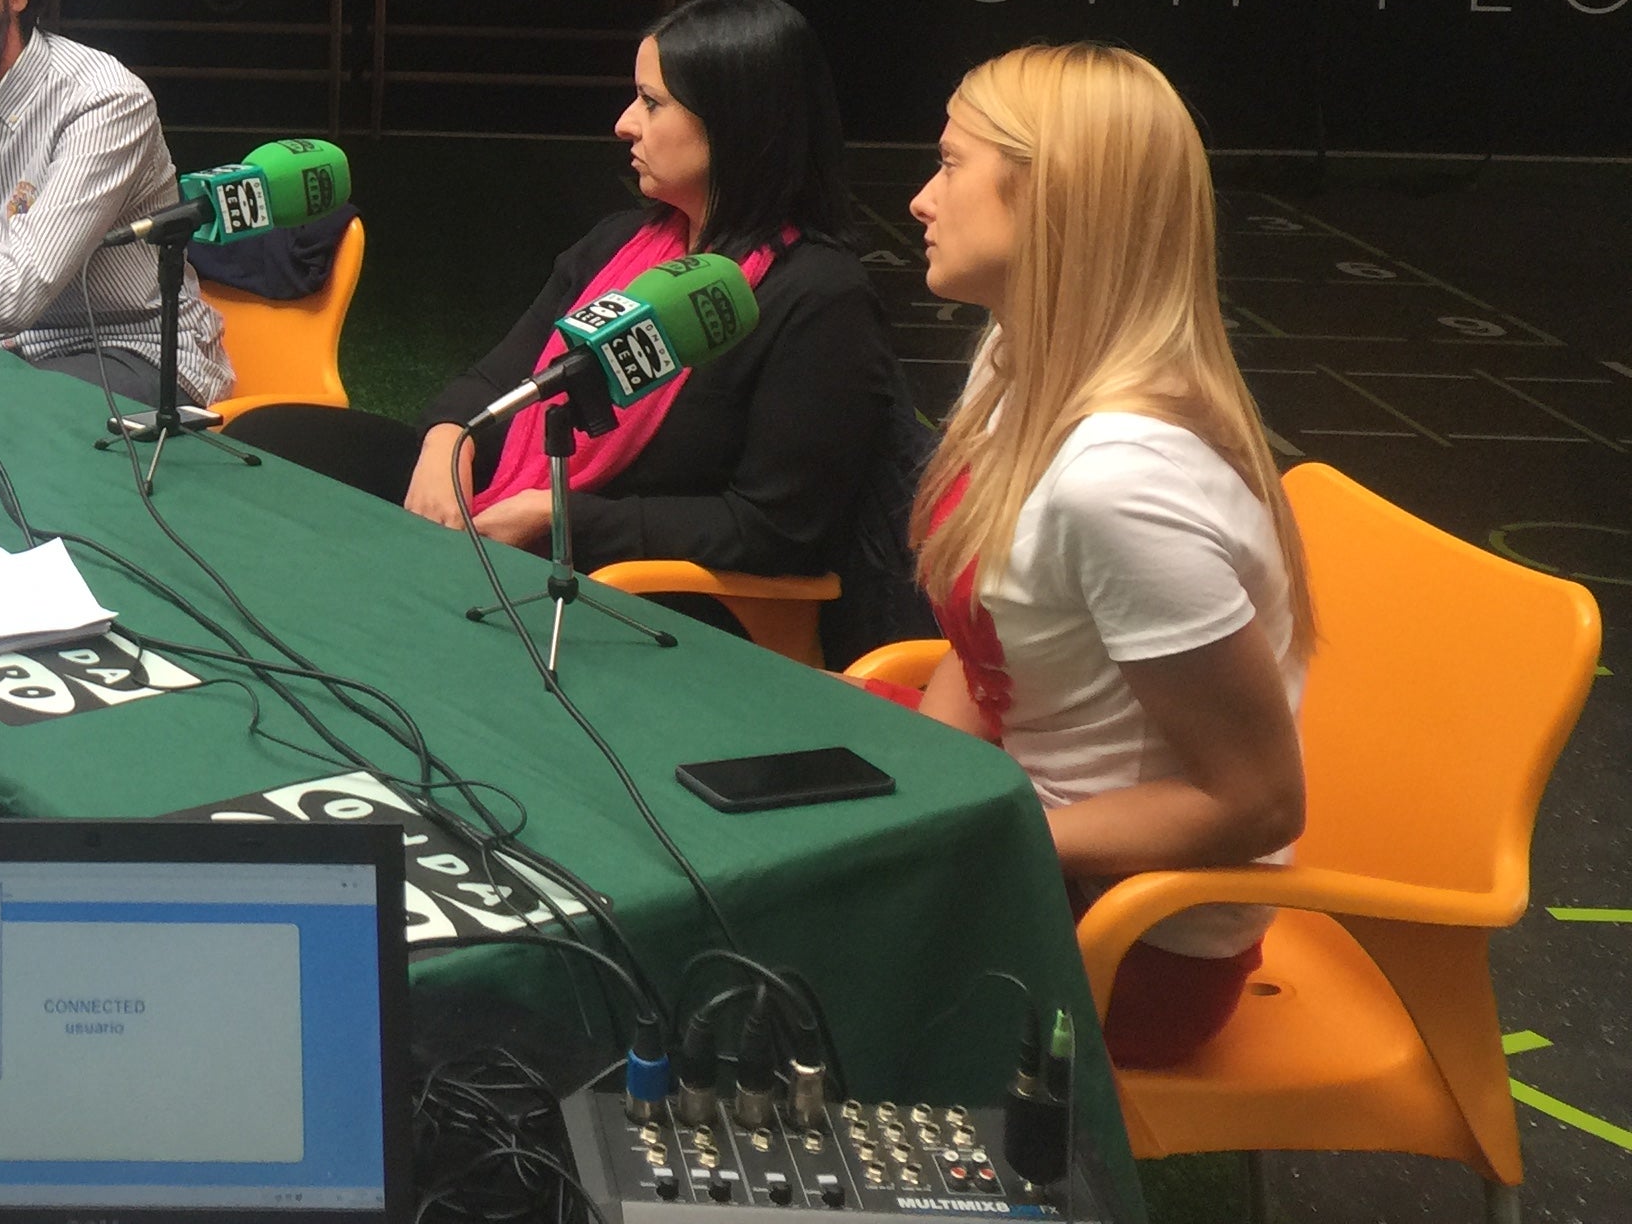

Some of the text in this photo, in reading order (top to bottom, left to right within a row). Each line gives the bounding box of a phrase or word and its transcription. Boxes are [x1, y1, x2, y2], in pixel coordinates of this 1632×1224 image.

[225, 184, 241, 228] CERO
[254, 182, 266, 222] ONDA
[612, 338, 642, 385] CERO
[645, 324, 671, 367] ONDA
[58, 649, 131, 686] DA
[43, 999, 146, 1015] CONNECTED
